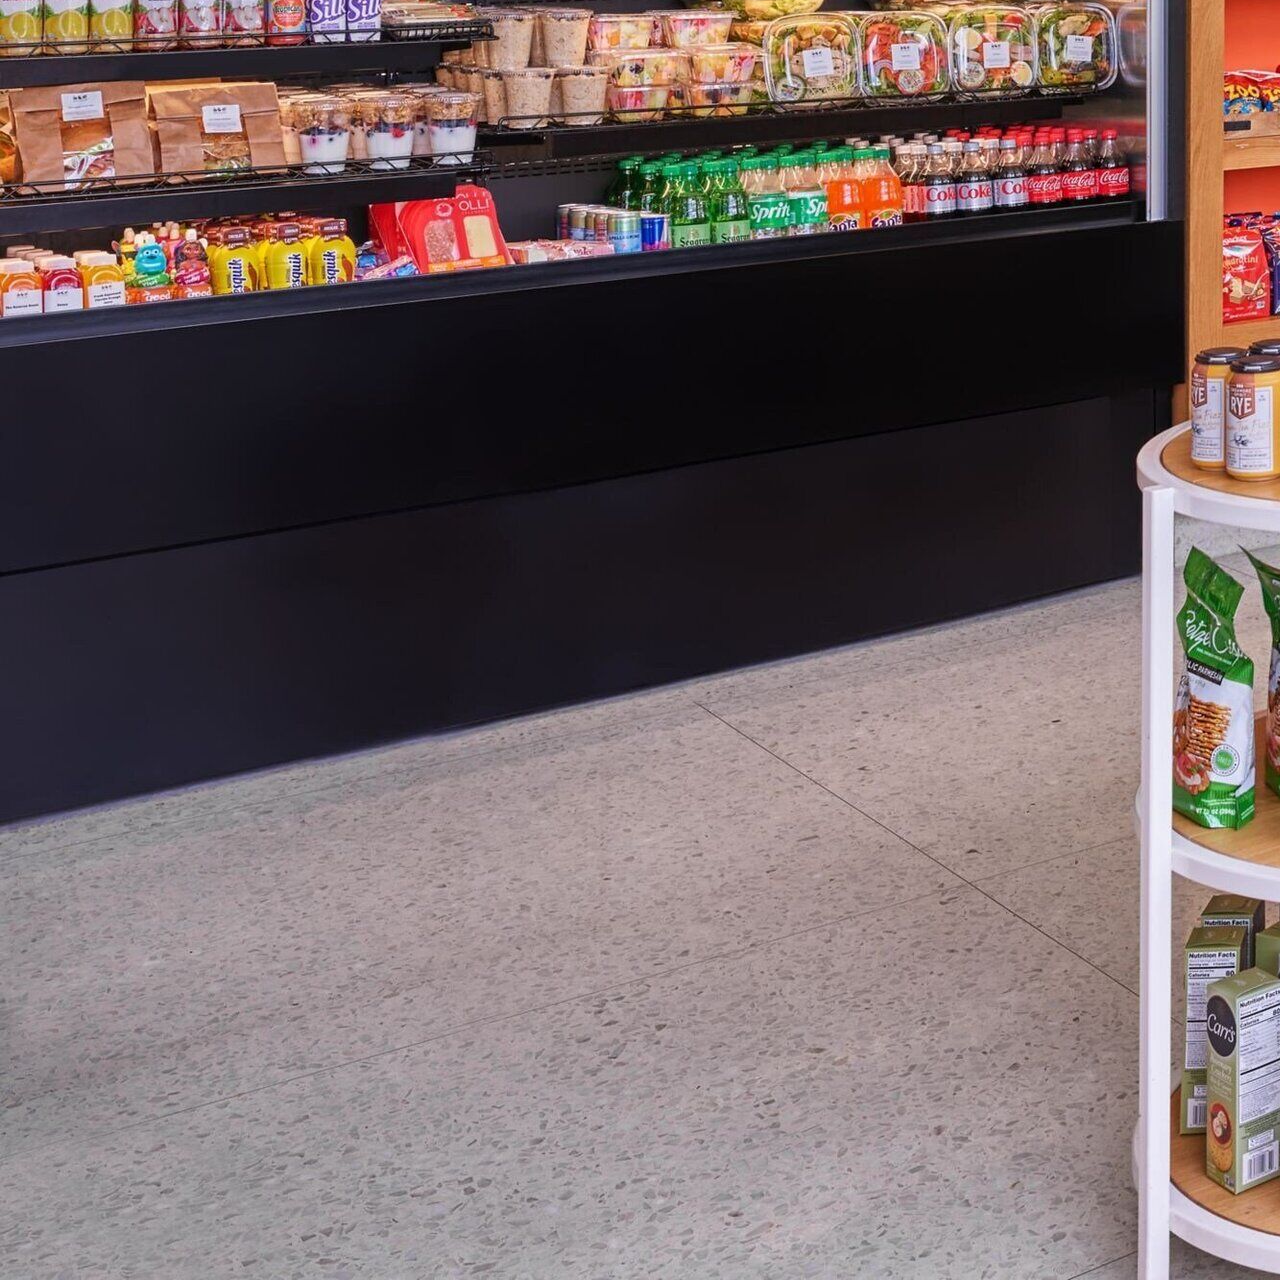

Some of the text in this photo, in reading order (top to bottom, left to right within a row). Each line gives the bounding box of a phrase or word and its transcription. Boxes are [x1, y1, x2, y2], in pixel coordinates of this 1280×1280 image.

[960, 186, 992, 200] Coke
[1230, 398, 1252, 417] RYE
[1189, 950, 1236, 960] Nutrition Facts
[1239, 989, 1280, 1009] Nutrition Facts
[1208, 1013, 1235, 1043] Carr's
